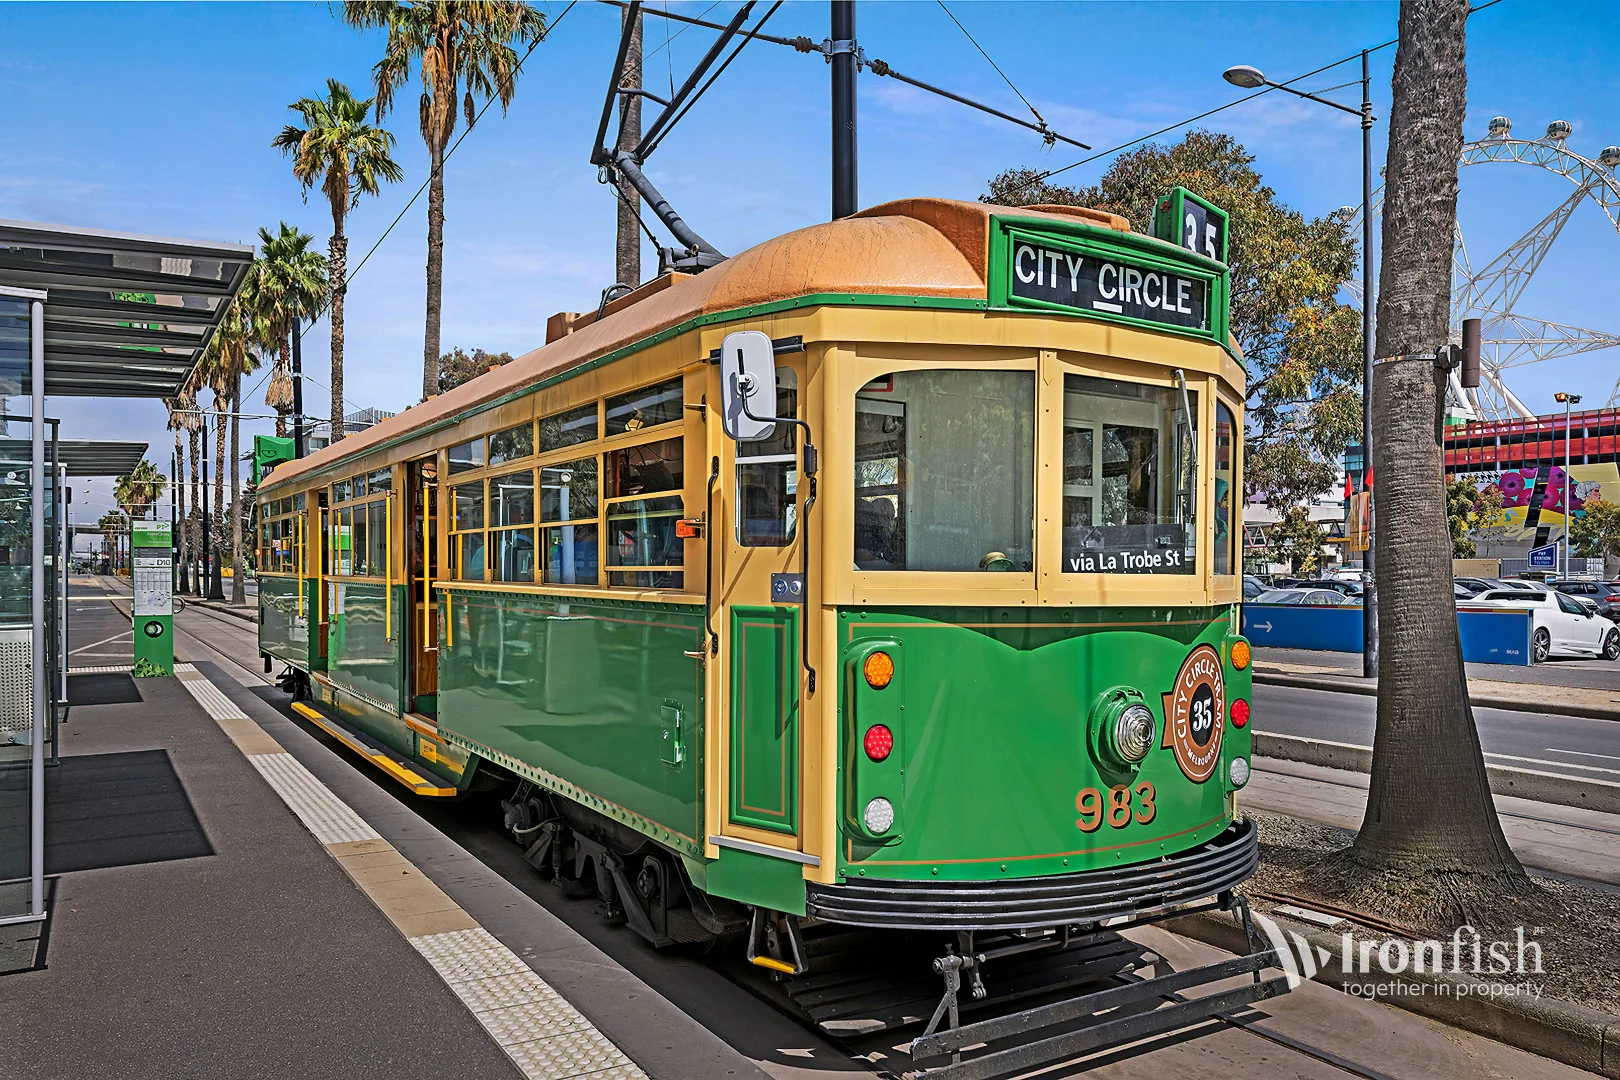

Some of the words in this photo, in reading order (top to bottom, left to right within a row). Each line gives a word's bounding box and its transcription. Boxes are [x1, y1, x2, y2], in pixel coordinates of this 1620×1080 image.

[1185, 212, 1217, 262] 35
[1015, 245, 1083, 292] CITY
[1098, 263, 1192, 314] CIRCLE
[1070, 553, 1096, 572] via
[1099, 553, 1117, 570] La
[1120, 550, 1162, 569] Trobe
[1165, 549, 1180, 566] St
[1177, 689, 1188, 739] CITY
[1185, 658, 1216, 689] CIRCLE
[1214, 671, 1222, 730] TRAM
[1192, 696, 1213, 732] 35
[1075, 781, 1156, 833] 983
